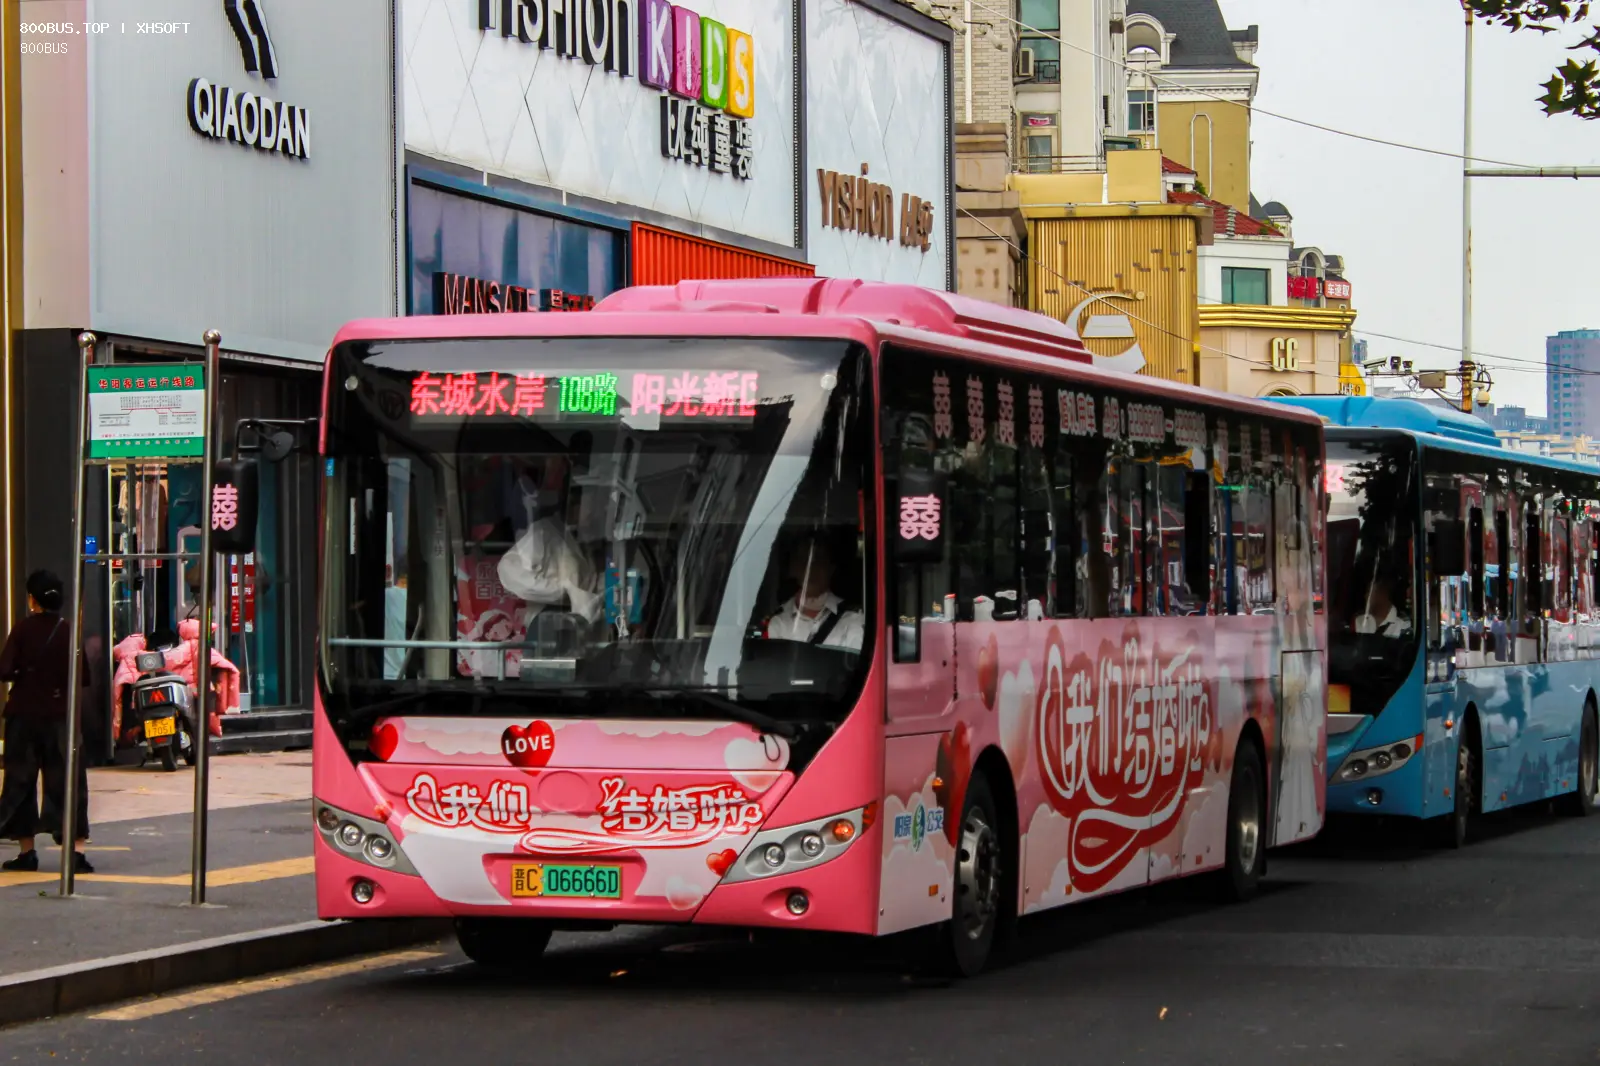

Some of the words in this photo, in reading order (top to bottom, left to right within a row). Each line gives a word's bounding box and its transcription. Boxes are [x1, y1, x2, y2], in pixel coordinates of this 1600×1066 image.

[648, 2, 750, 110] KIDS
[188, 77, 310, 159] QIAODAN
[660, 95, 753, 180] 以纯童装
[410, 371, 545, 417] 东城水岸
[558, 374, 618, 417] 108路
[504, 733, 552, 755] LOVE
[1040, 640, 1210, 805] 我们结婚啦
[408, 774, 531, 832] 我们
[600, 778, 764, 834] 结婚啦
